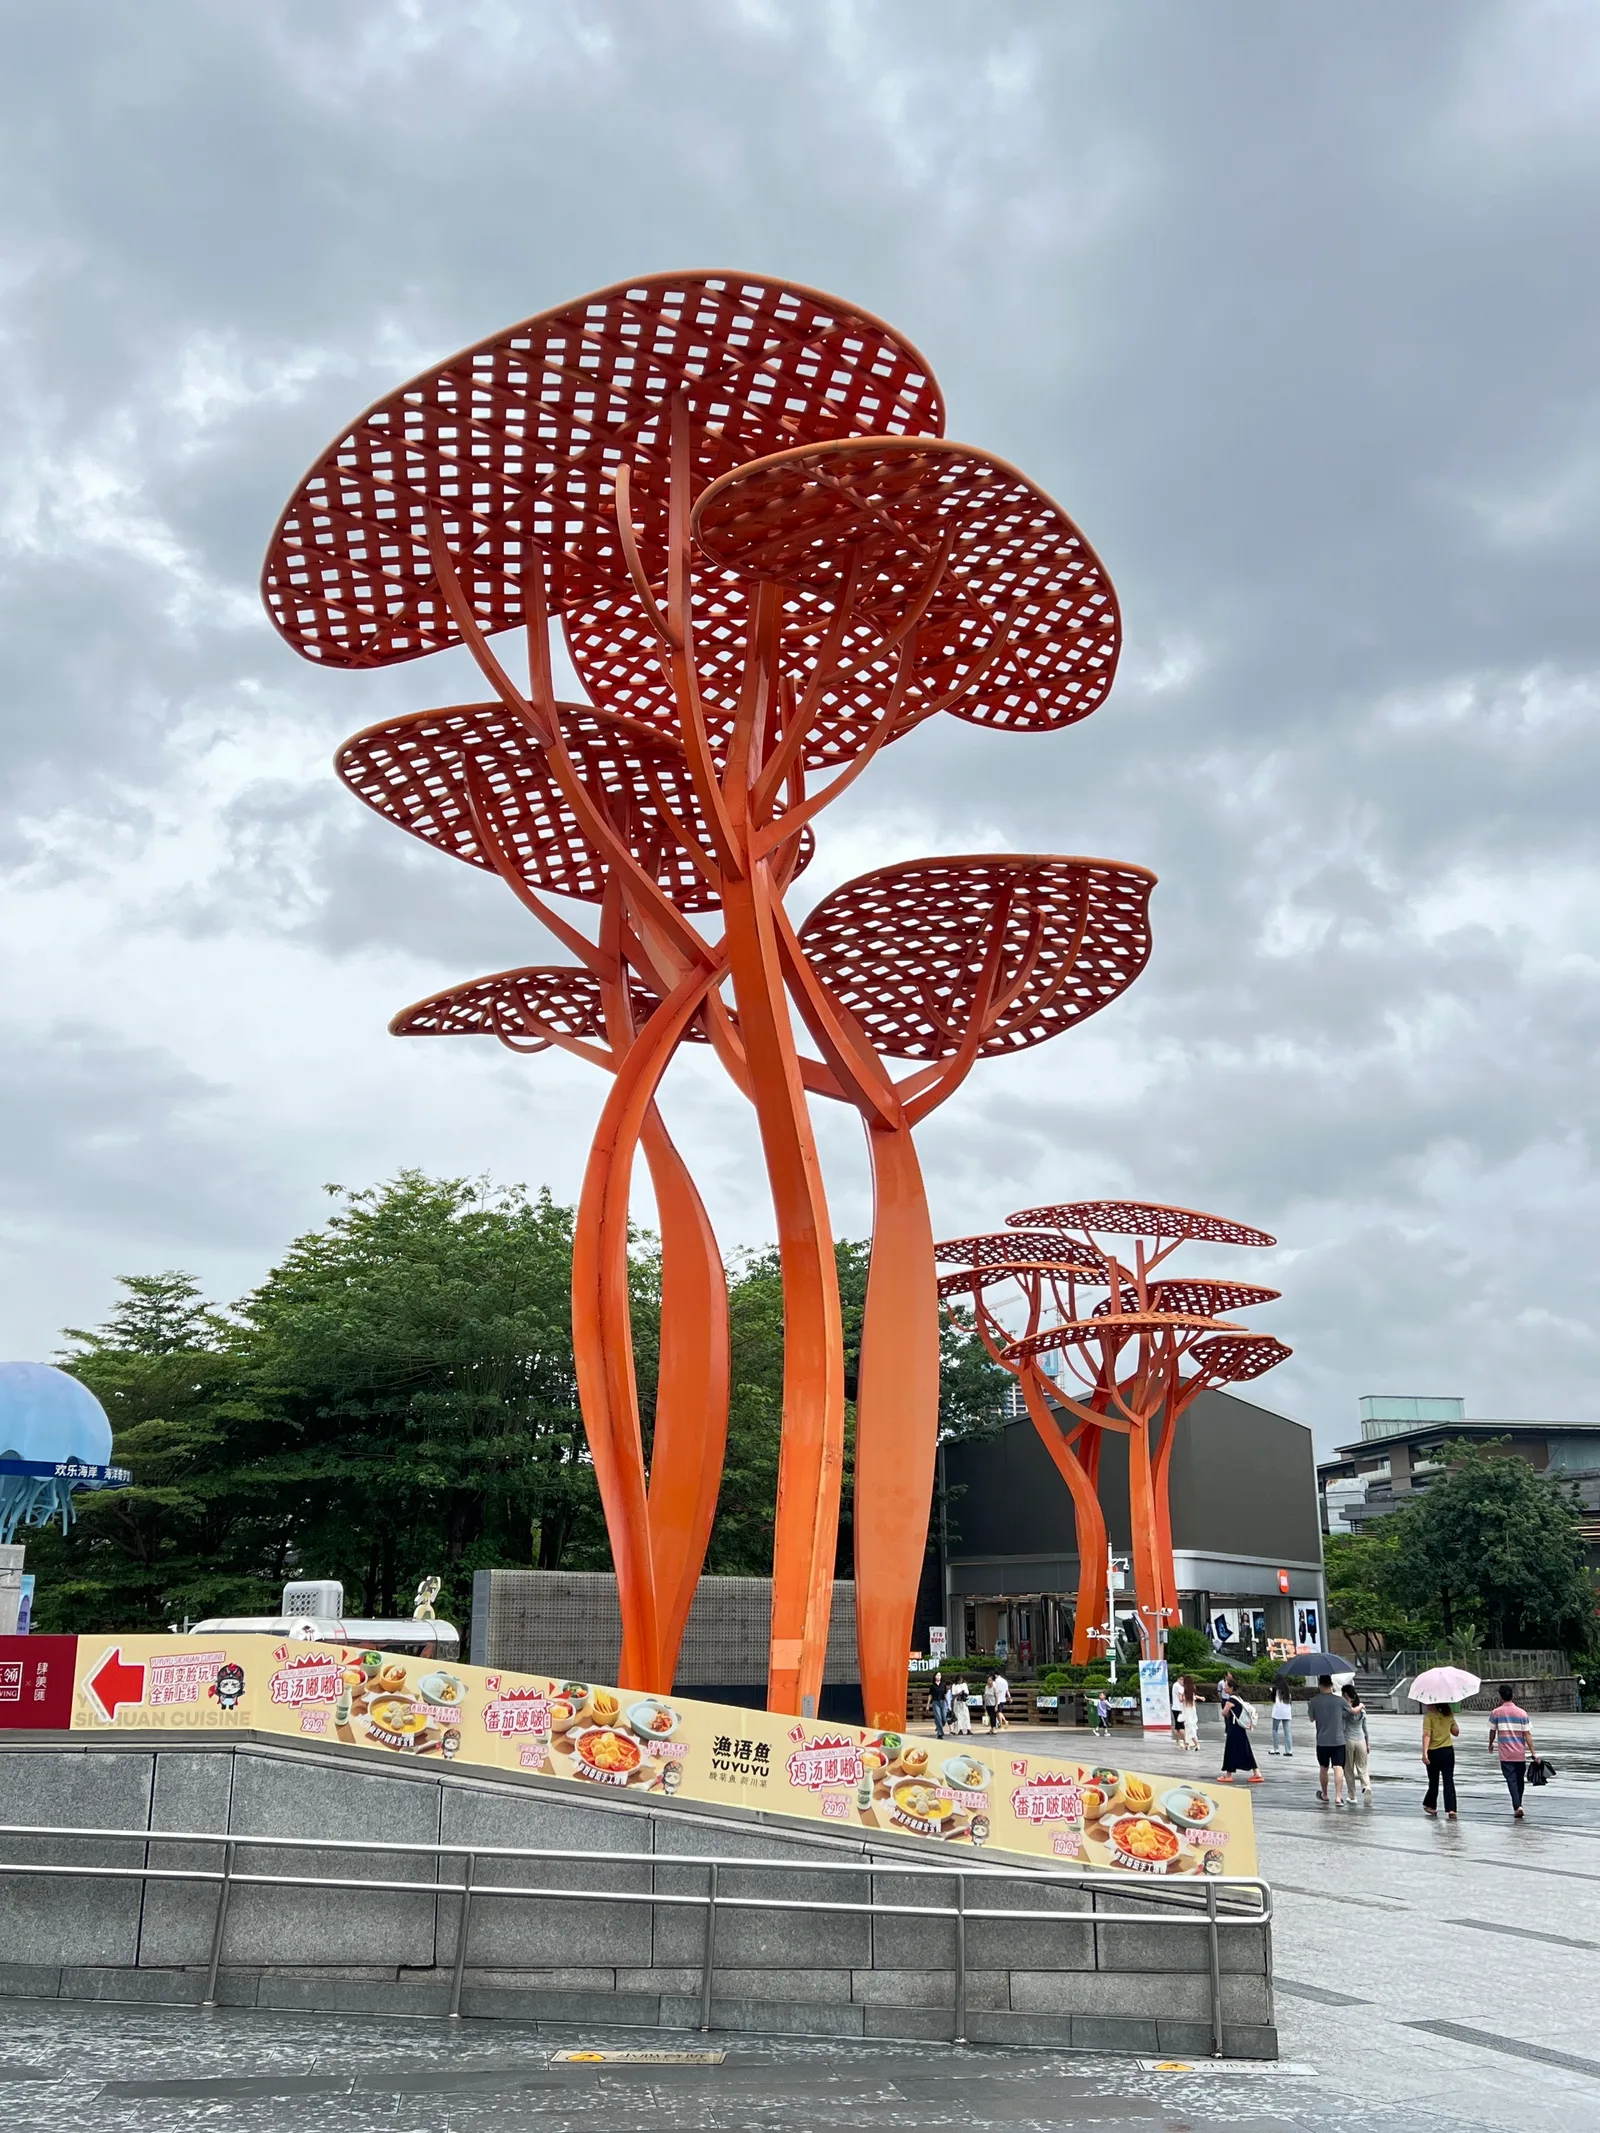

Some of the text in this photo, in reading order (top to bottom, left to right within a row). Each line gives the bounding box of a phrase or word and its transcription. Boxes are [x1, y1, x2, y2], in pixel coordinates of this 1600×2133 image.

[54, 1464, 98, 1479] 欢乐海岸
[174, 1656, 200, 1664] SICHUAN
[200, 1653, 223, 1662] CUISINE
[151, 1665, 219, 1685] 川剧变脸玩具
[152, 1685, 198, 1703] 全新上线
[275, 1675, 335, 1699] 鸡汤嘟嘟
[171, 1711, 251, 1726] CUISINE
[712, 1759, 769, 1777] YUYUYU
[793, 1757, 855, 1781] 鸡汤嘟嘟
[709, 1771, 768, 1788] 酸菜鱼 新川菜
